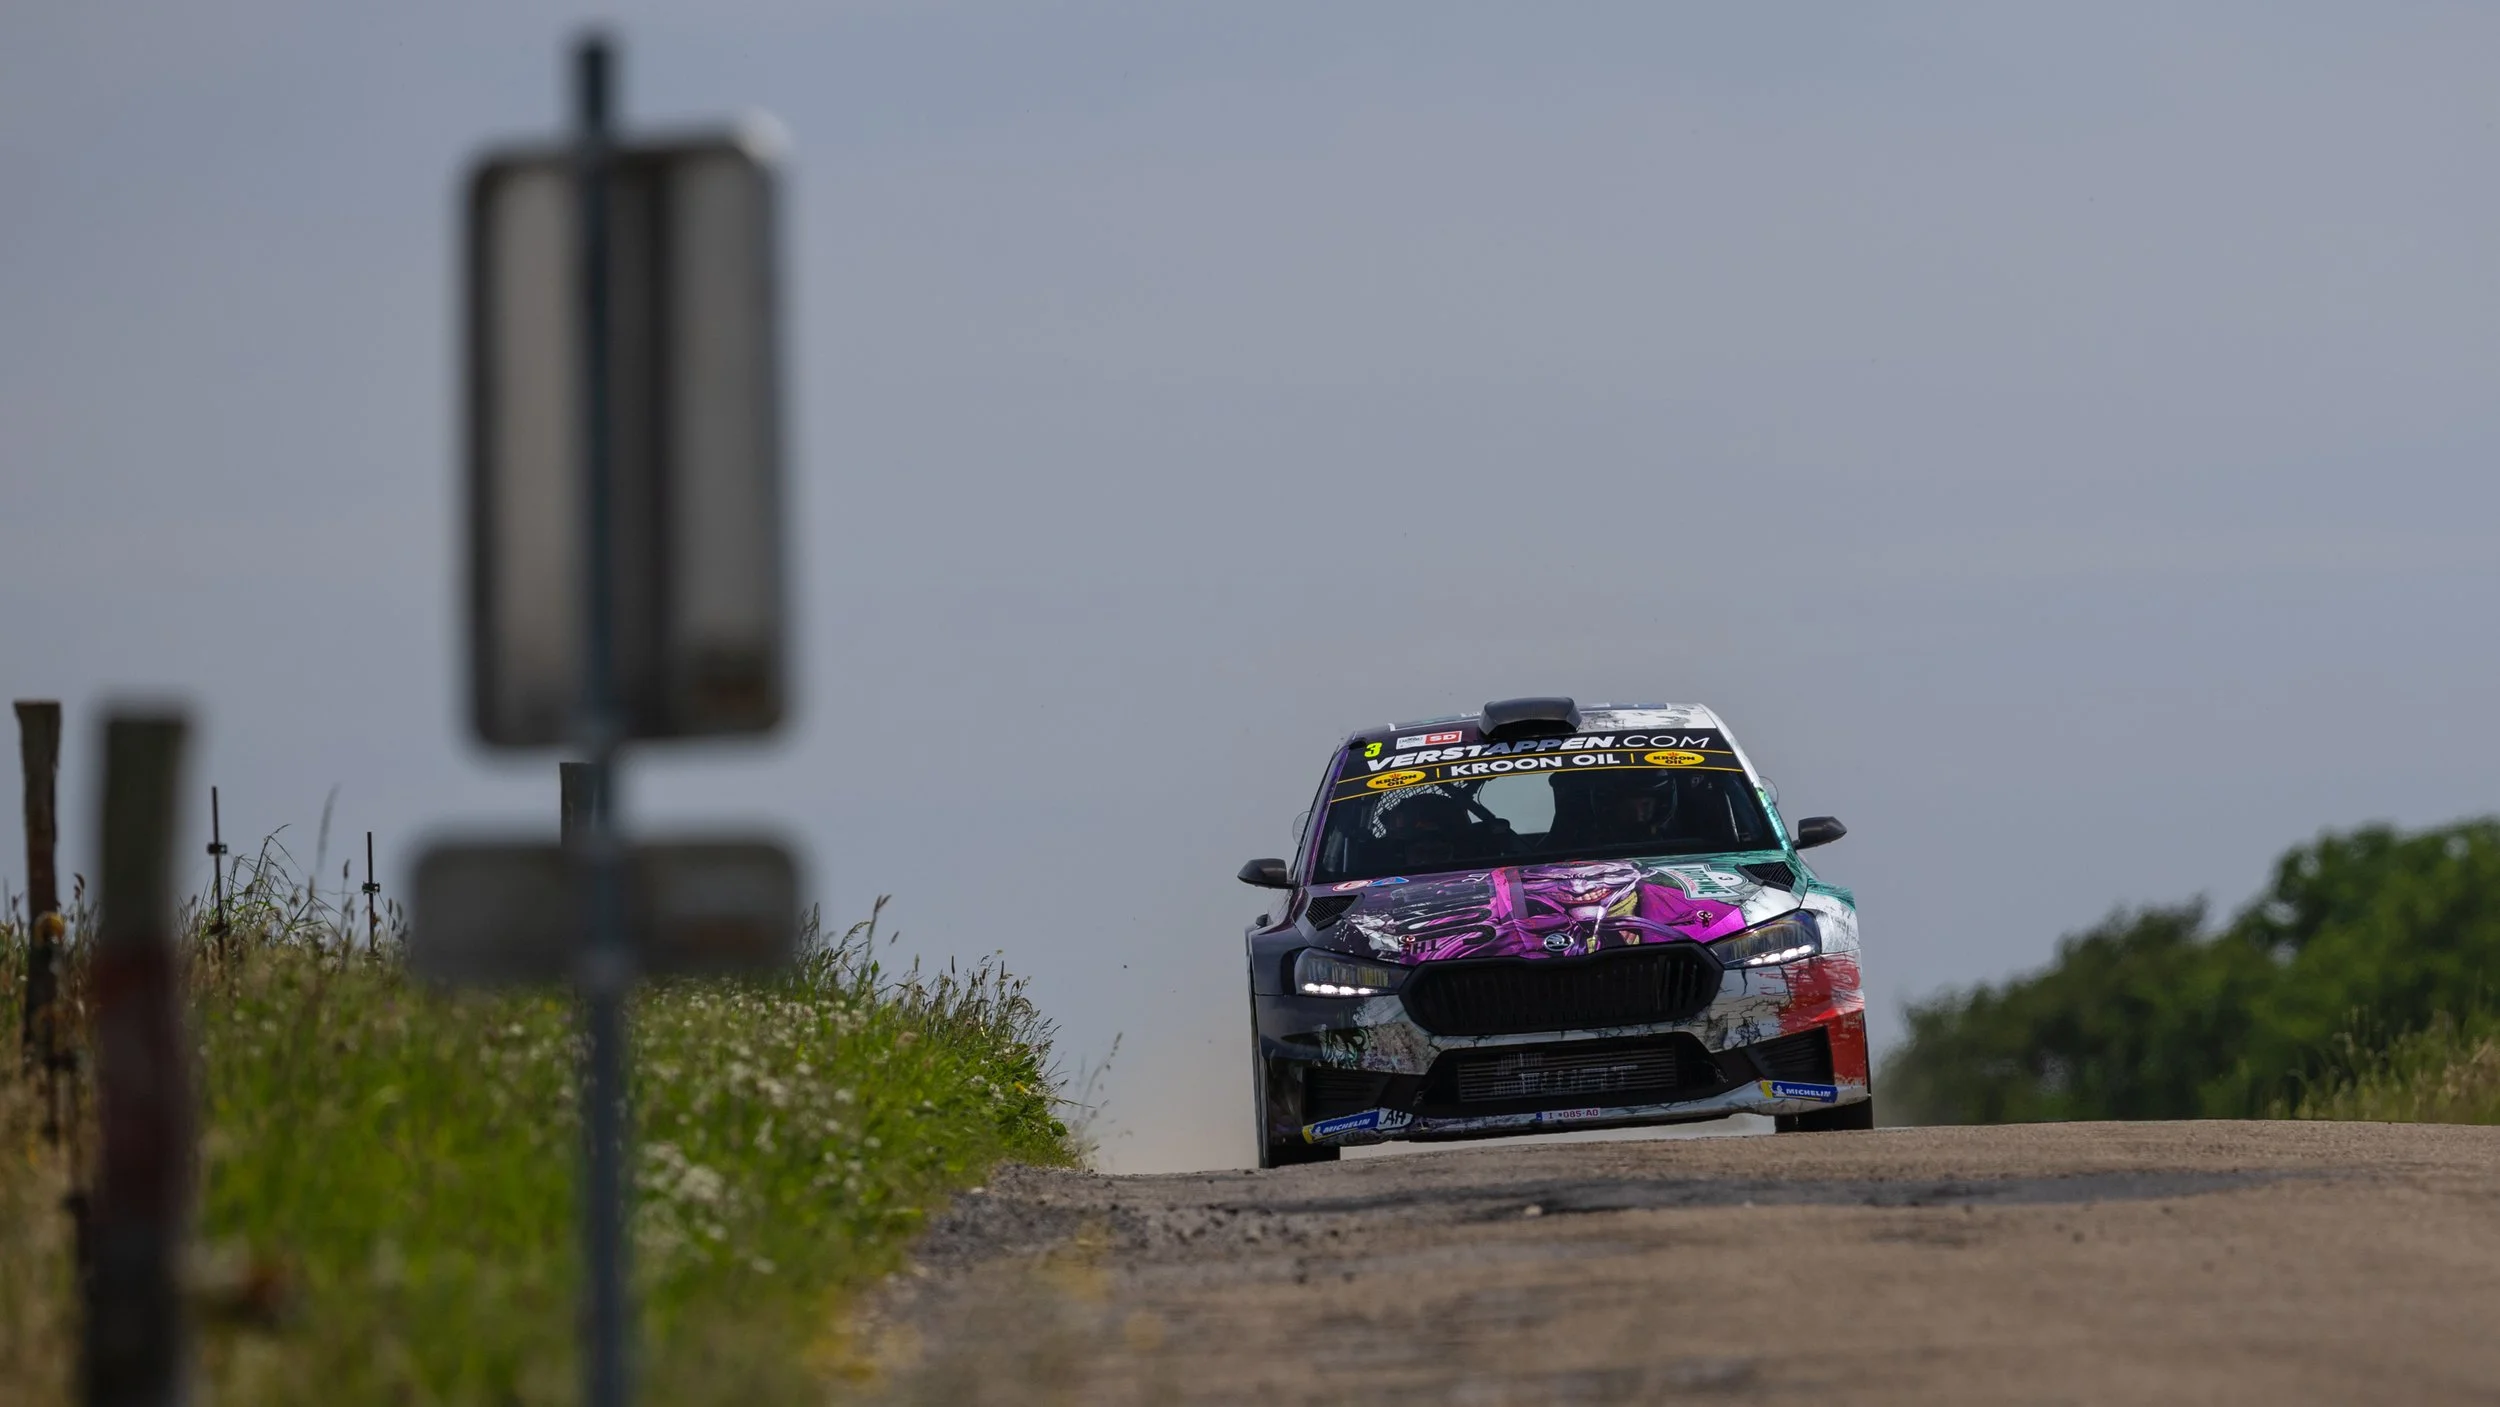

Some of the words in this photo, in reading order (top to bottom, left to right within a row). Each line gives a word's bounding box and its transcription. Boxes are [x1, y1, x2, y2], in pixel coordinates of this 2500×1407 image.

[1430, 734, 1457, 742] SD
[1364, 742, 1383, 758] 3
[1367, 735, 1710, 772] VERSTAPPEN.COM
[1451, 756, 1562, 776] KROON
[1572, 753, 1620, 766] OIL
[1375, 774, 1417, 785] KROON
[1786, 1088, 1831, 1097] MICHELIN
[1322, 1118, 1371, 1134] MICHELIN
